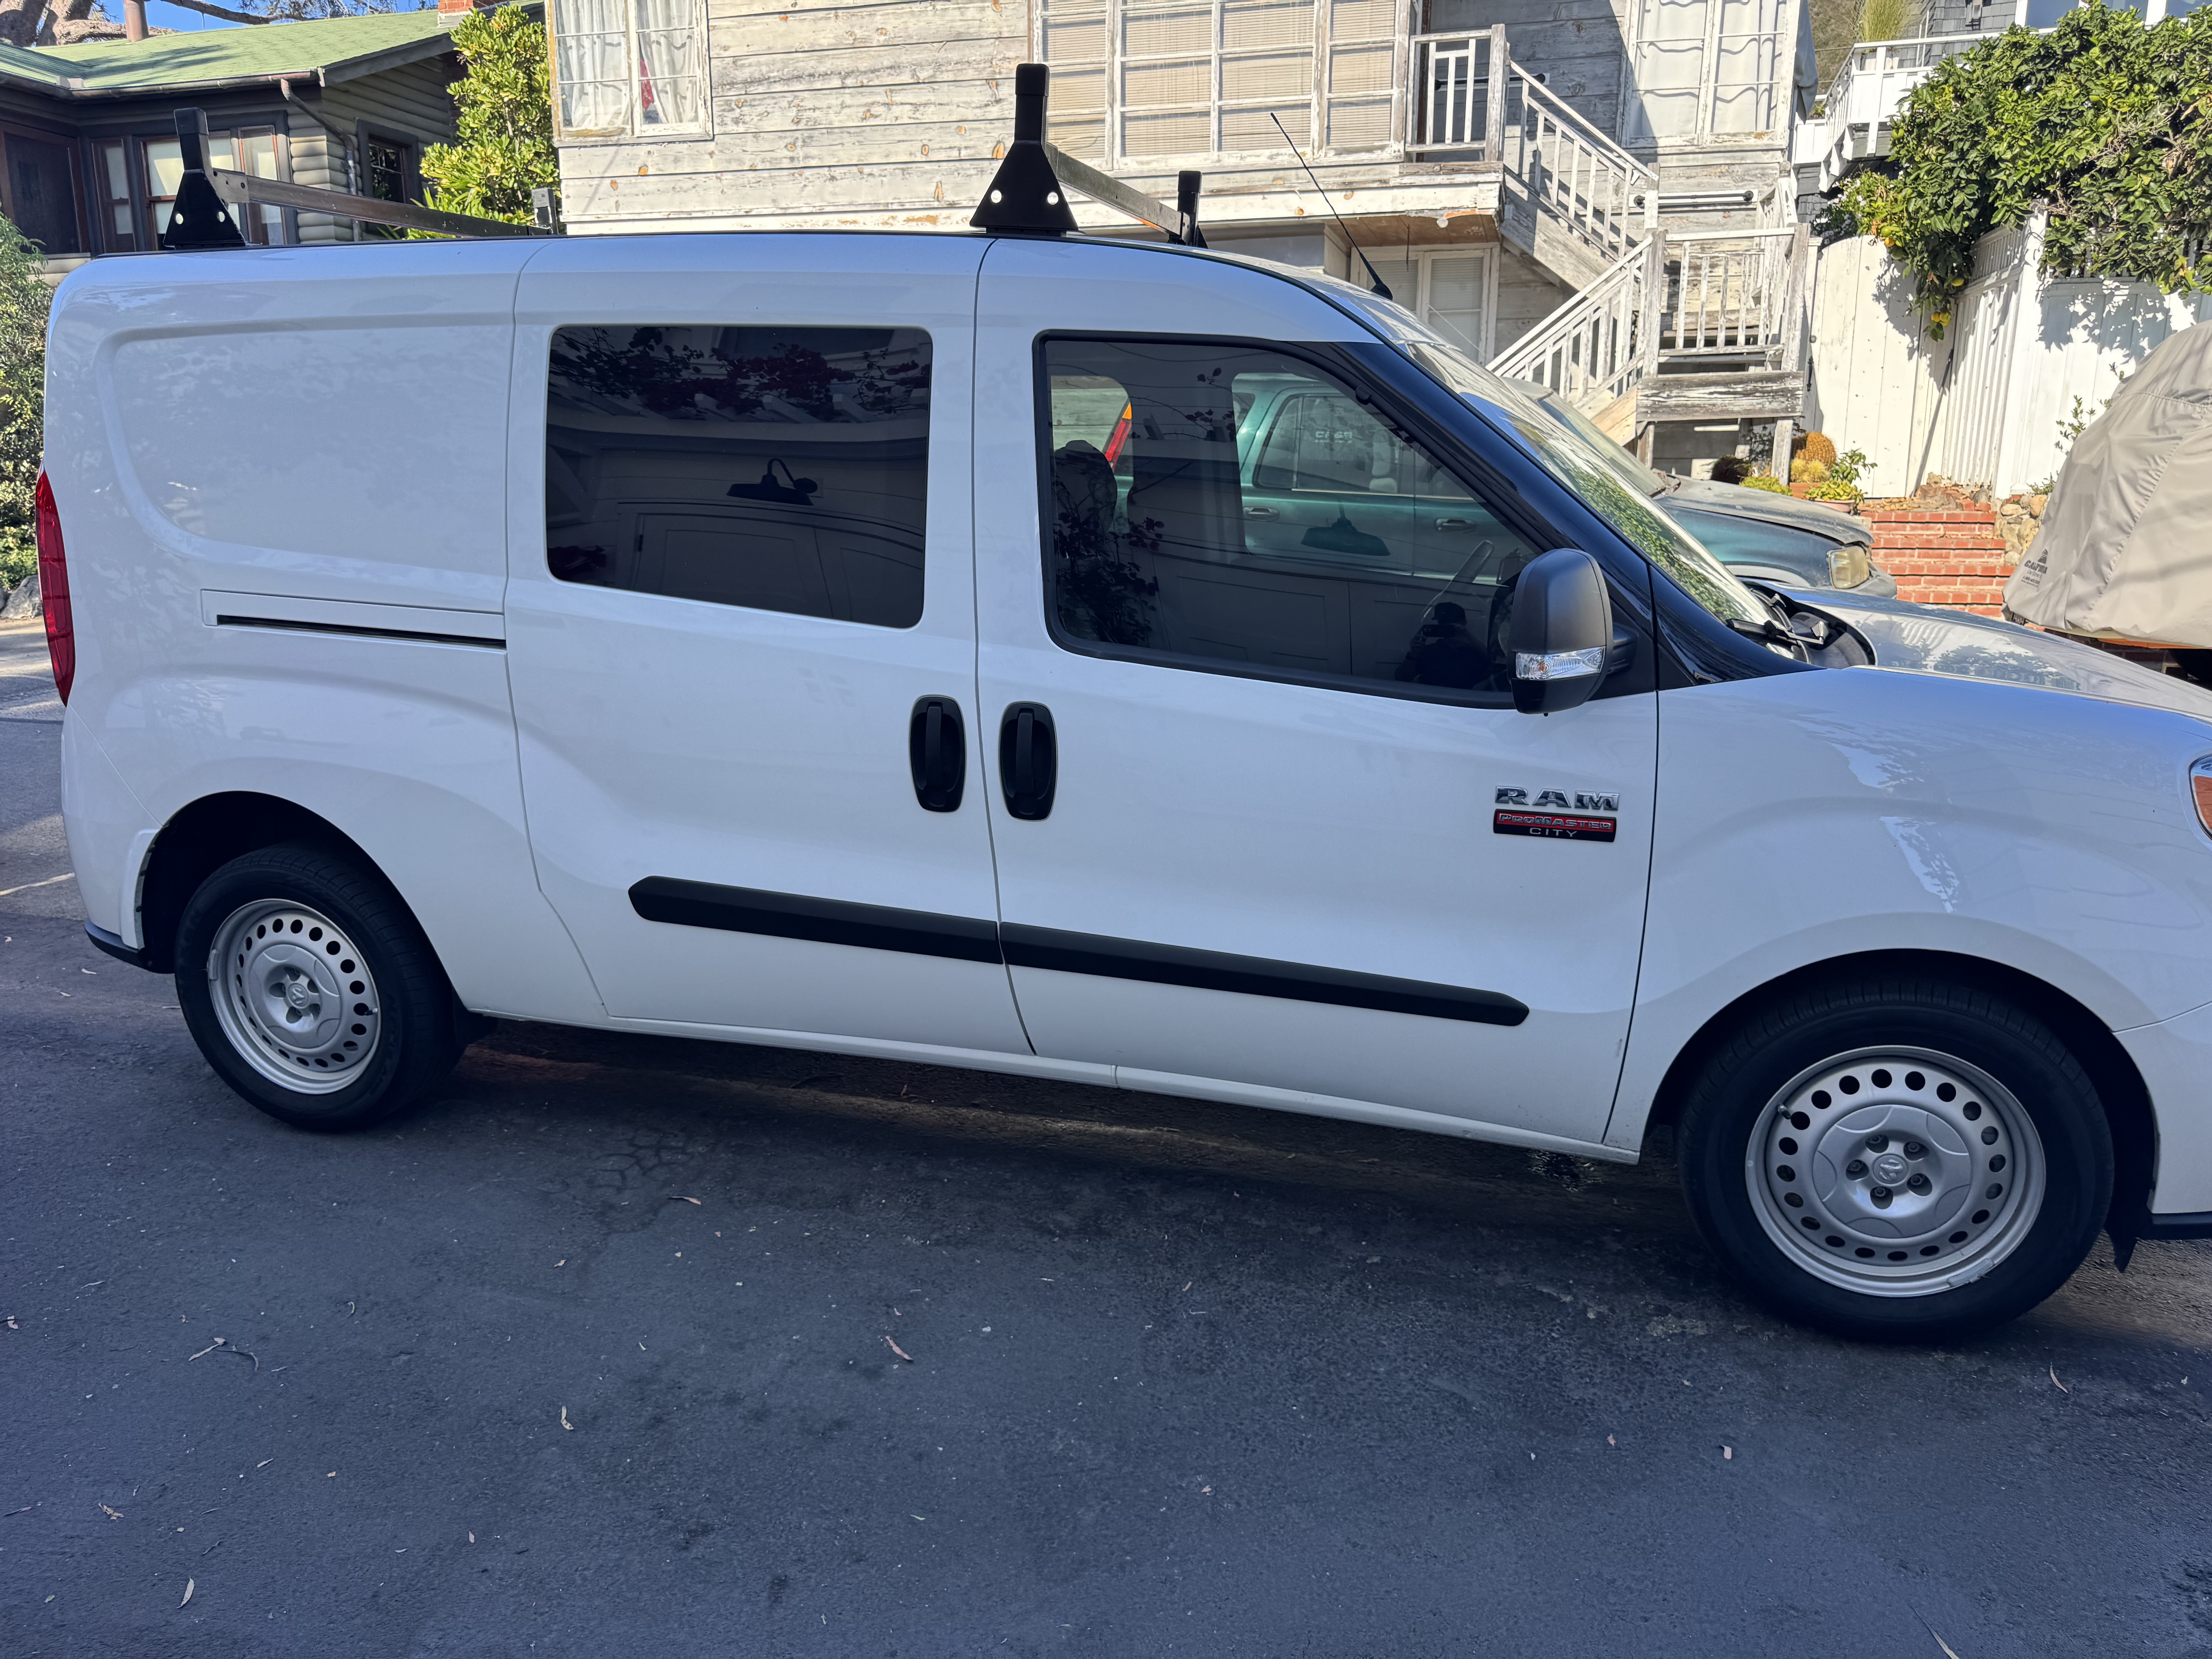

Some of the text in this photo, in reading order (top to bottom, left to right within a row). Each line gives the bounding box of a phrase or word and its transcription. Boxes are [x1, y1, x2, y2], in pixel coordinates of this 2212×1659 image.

[1495, 786, 1620, 811] RAM
[1499, 813, 1611, 830] PROMASTER
[1530, 827, 1578, 837] CITY
